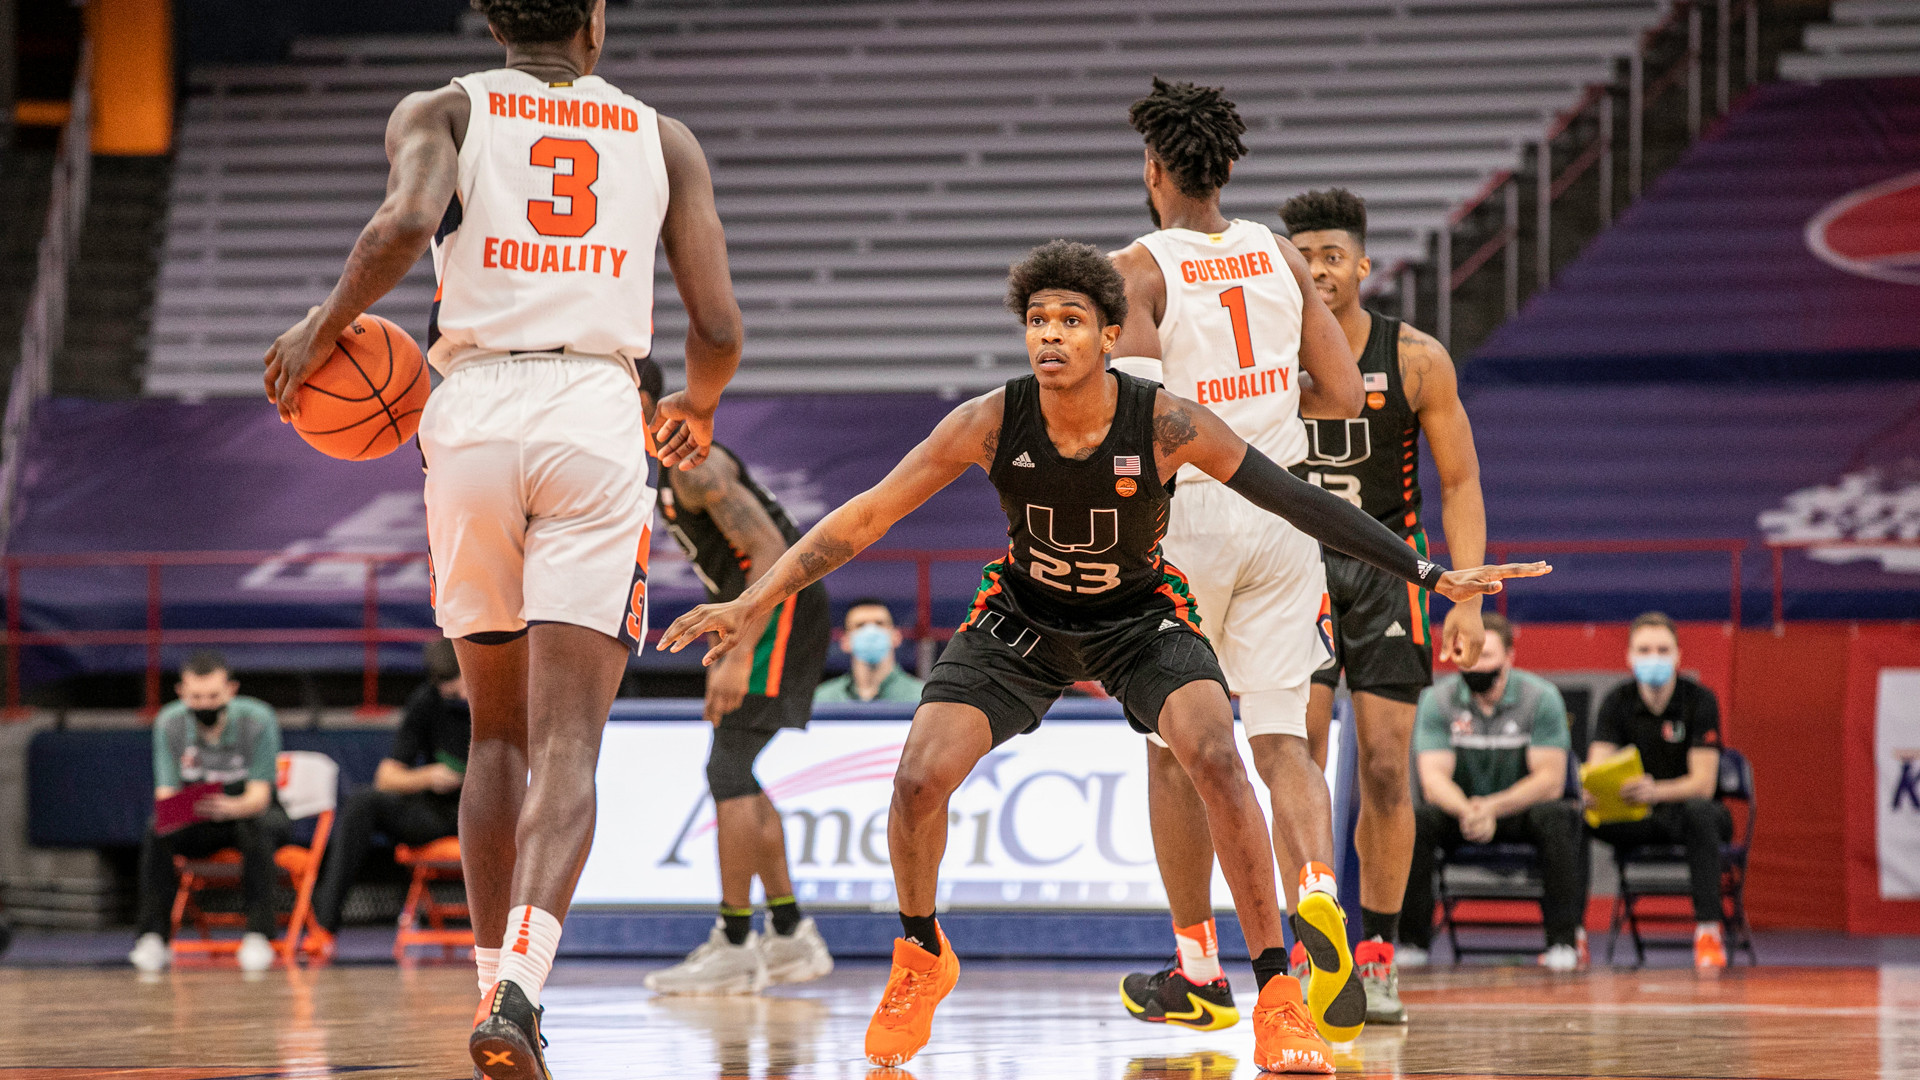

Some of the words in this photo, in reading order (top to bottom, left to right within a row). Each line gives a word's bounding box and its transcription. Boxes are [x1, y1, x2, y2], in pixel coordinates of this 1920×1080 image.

[488, 91, 640, 133] RICHMOND
[527, 136, 599, 238] 3
[482, 236, 628, 279] EQUALITY
[1180, 251, 1274, 284] GUERRIER
[1218, 286, 1256, 370] 1
[1196, 366, 1291, 406] EQUALITY
[1012, 460, 1036, 468] adidas
[1026, 503, 1119, 555] U
[1029, 546, 1122, 595] 23
